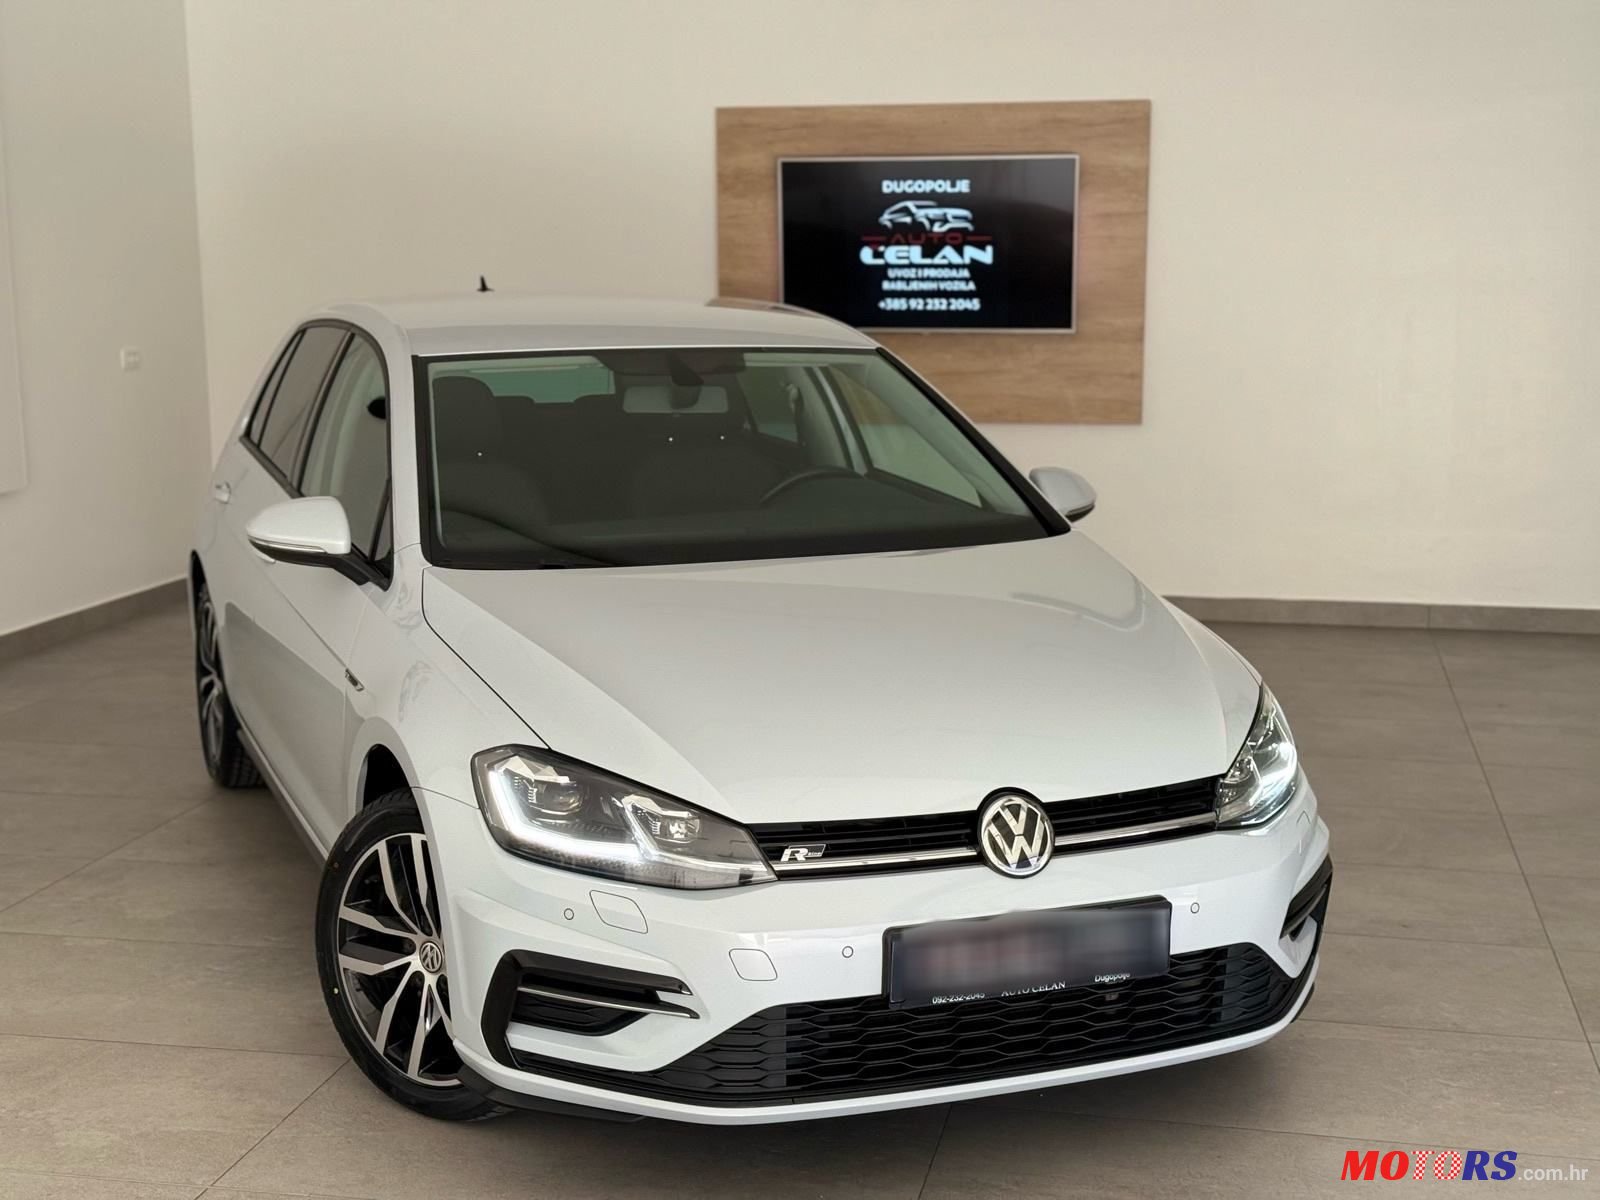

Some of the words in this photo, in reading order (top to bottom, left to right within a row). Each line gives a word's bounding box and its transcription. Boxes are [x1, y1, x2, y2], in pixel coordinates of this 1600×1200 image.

[881, 179, 971, 194] DUGOPOLJE
[889, 232, 964, 245] AUTO
[908, 298, 925, 311] 92
[949, 298, 981, 311] 2045
